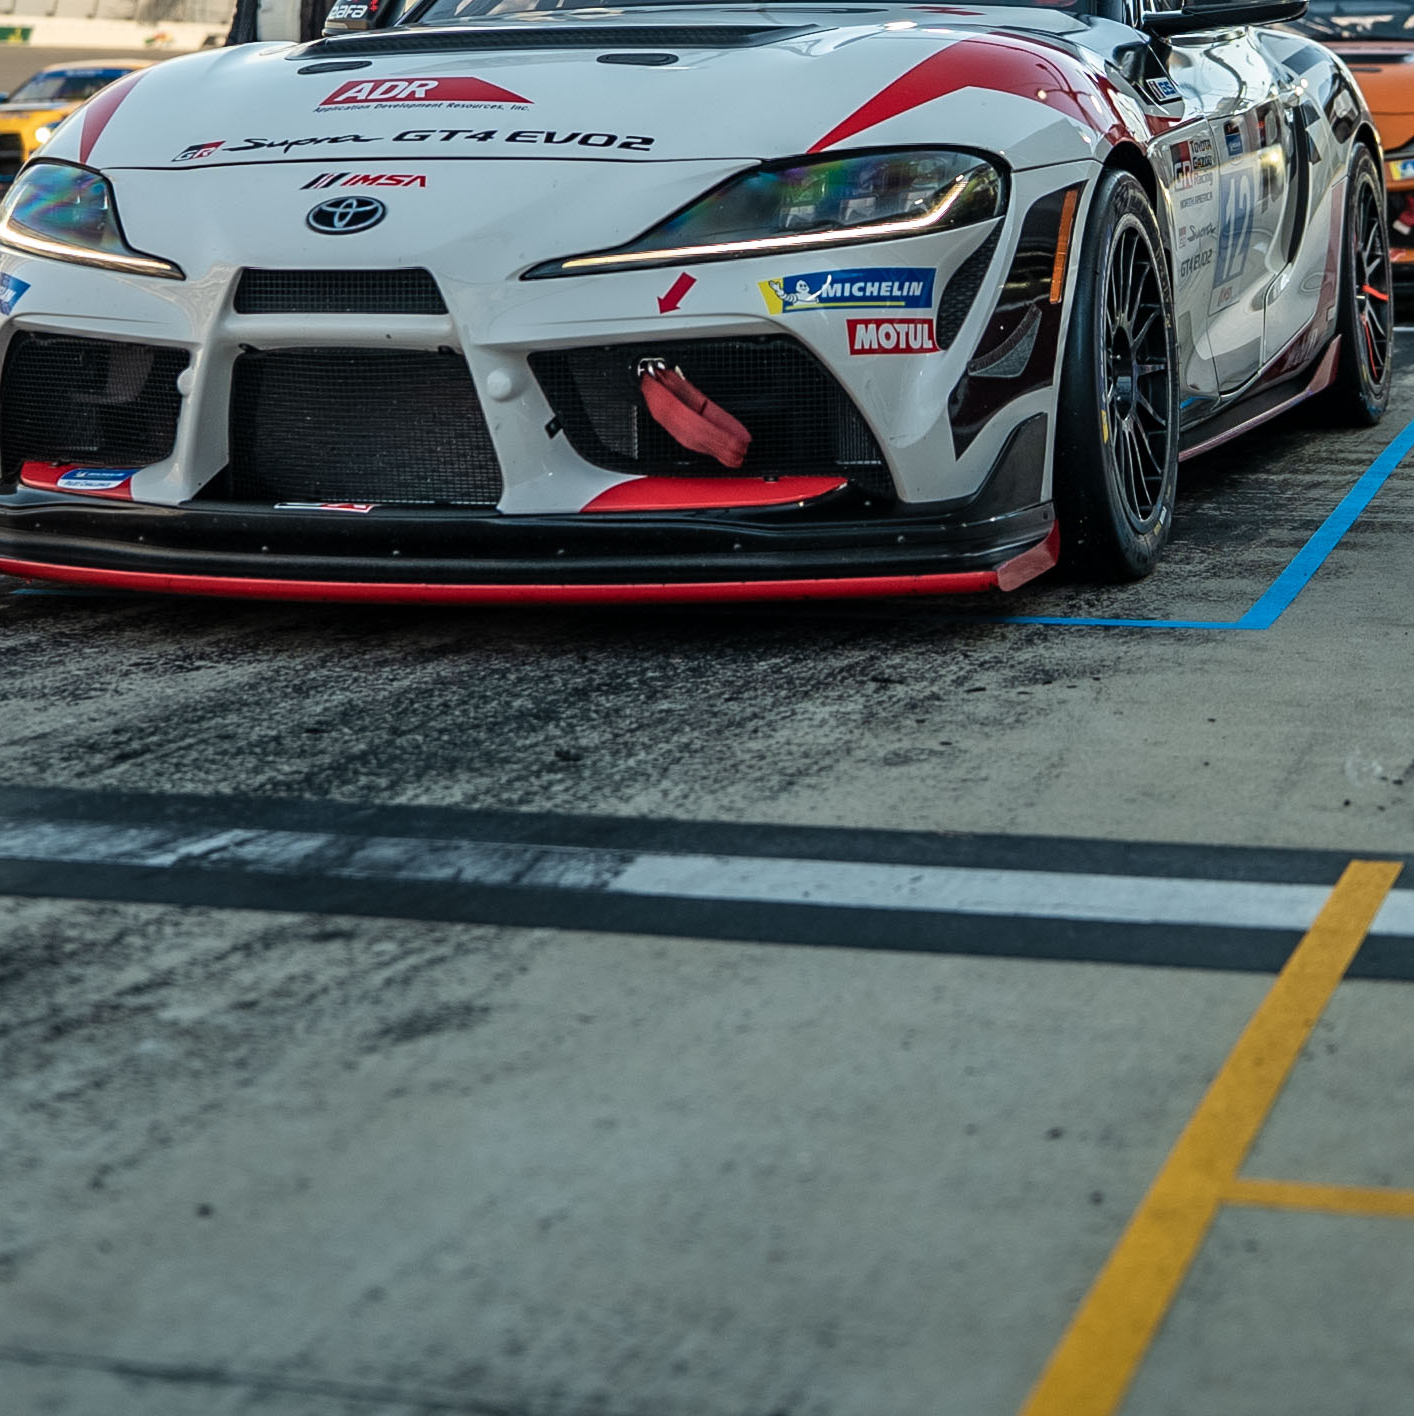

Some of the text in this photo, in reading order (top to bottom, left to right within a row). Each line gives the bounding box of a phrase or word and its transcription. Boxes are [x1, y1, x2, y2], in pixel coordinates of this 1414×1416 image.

[333, 80, 439, 102] ADR
[312, 103, 371, 113] Application
[373, 101, 442, 110] Development
[509, 103, 531, 112] Inc.
[222, 133, 385, 154] Supra
[391, 129, 499, 143] GT4
[504, 130, 656, 152] EVO2
[339, 173, 428, 188] IMSA
[1222, 174, 1251, 281] 12
[821, 281, 924, 298] MICHELIN
[853, 323, 934, 350] MOTUL
